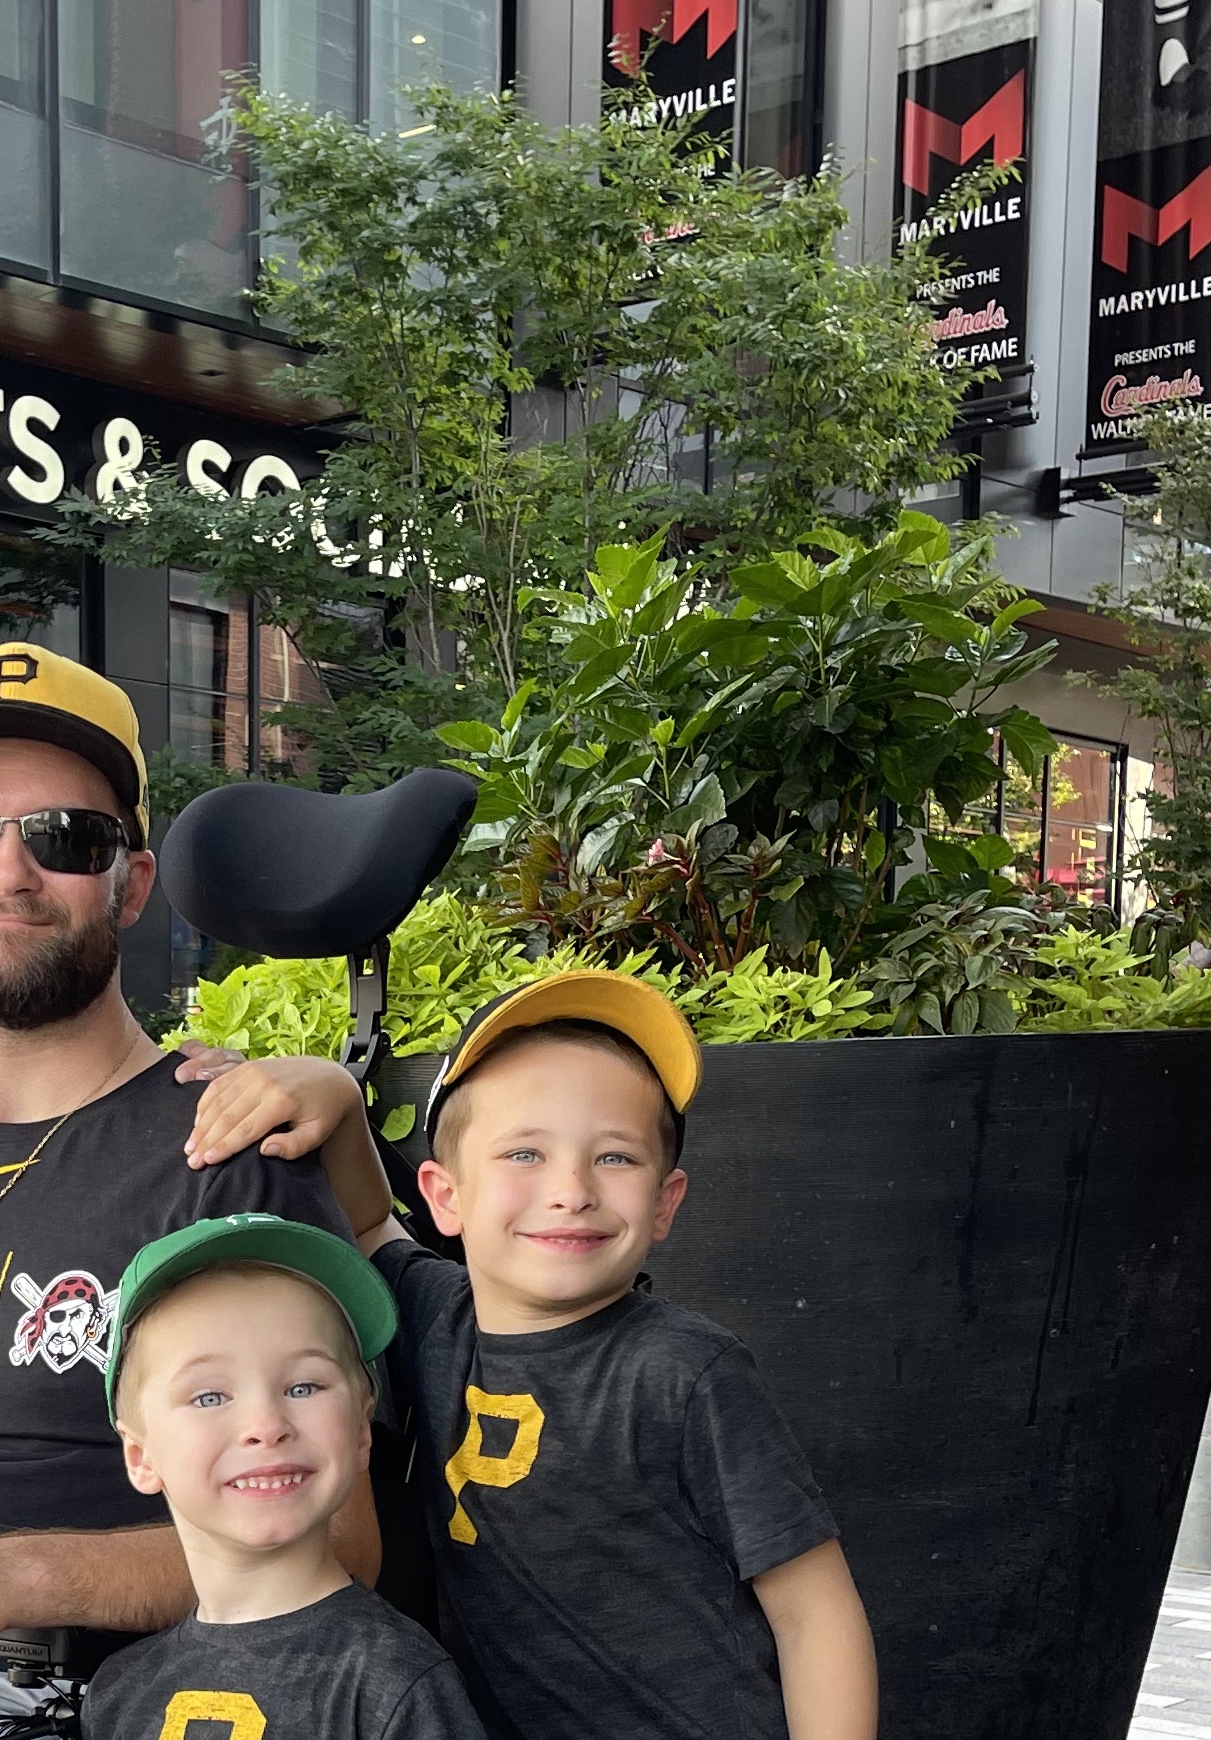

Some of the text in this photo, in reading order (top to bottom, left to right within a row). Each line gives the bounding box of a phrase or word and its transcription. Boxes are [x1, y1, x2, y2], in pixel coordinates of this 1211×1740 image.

[976, 267, 1001, 286] THE
[1098, 275, 1211, 318] MARYVILLE
[970, 337, 1018, 367] FAME
[1114, 339, 1196, 368] PRESENTS THE
[1100, 368, 1205, 418] Cardinals
[97, 416, 154, 524] &
